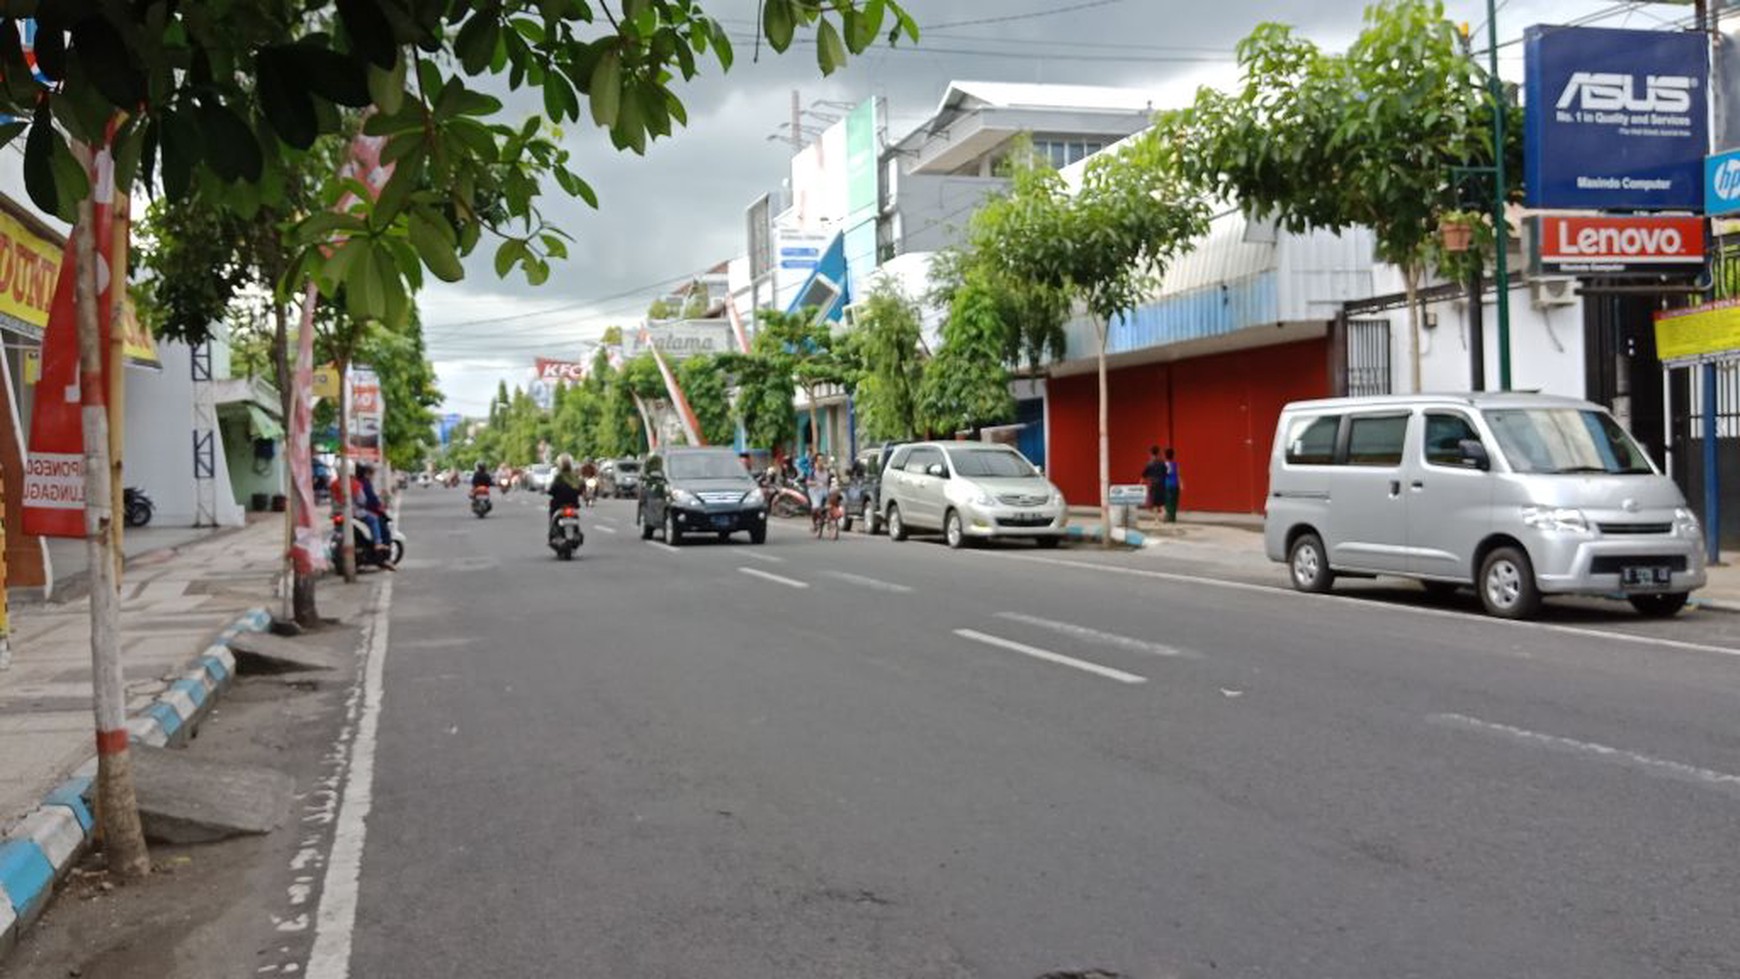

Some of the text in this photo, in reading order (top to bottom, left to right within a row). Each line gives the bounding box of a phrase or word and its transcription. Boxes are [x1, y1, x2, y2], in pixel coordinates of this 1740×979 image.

[1555, 72, 1690, 112] ASUS
[1583, 111, 1594, 123] in
[1595, 112, 1629, 126] Quality
[1630, 114, 1648, 124] and
[1650, 114, 1691, 126] Services
[1622, 177, 1672, 191] Computer
[1558, 220, 1682, 254] Lenovo
